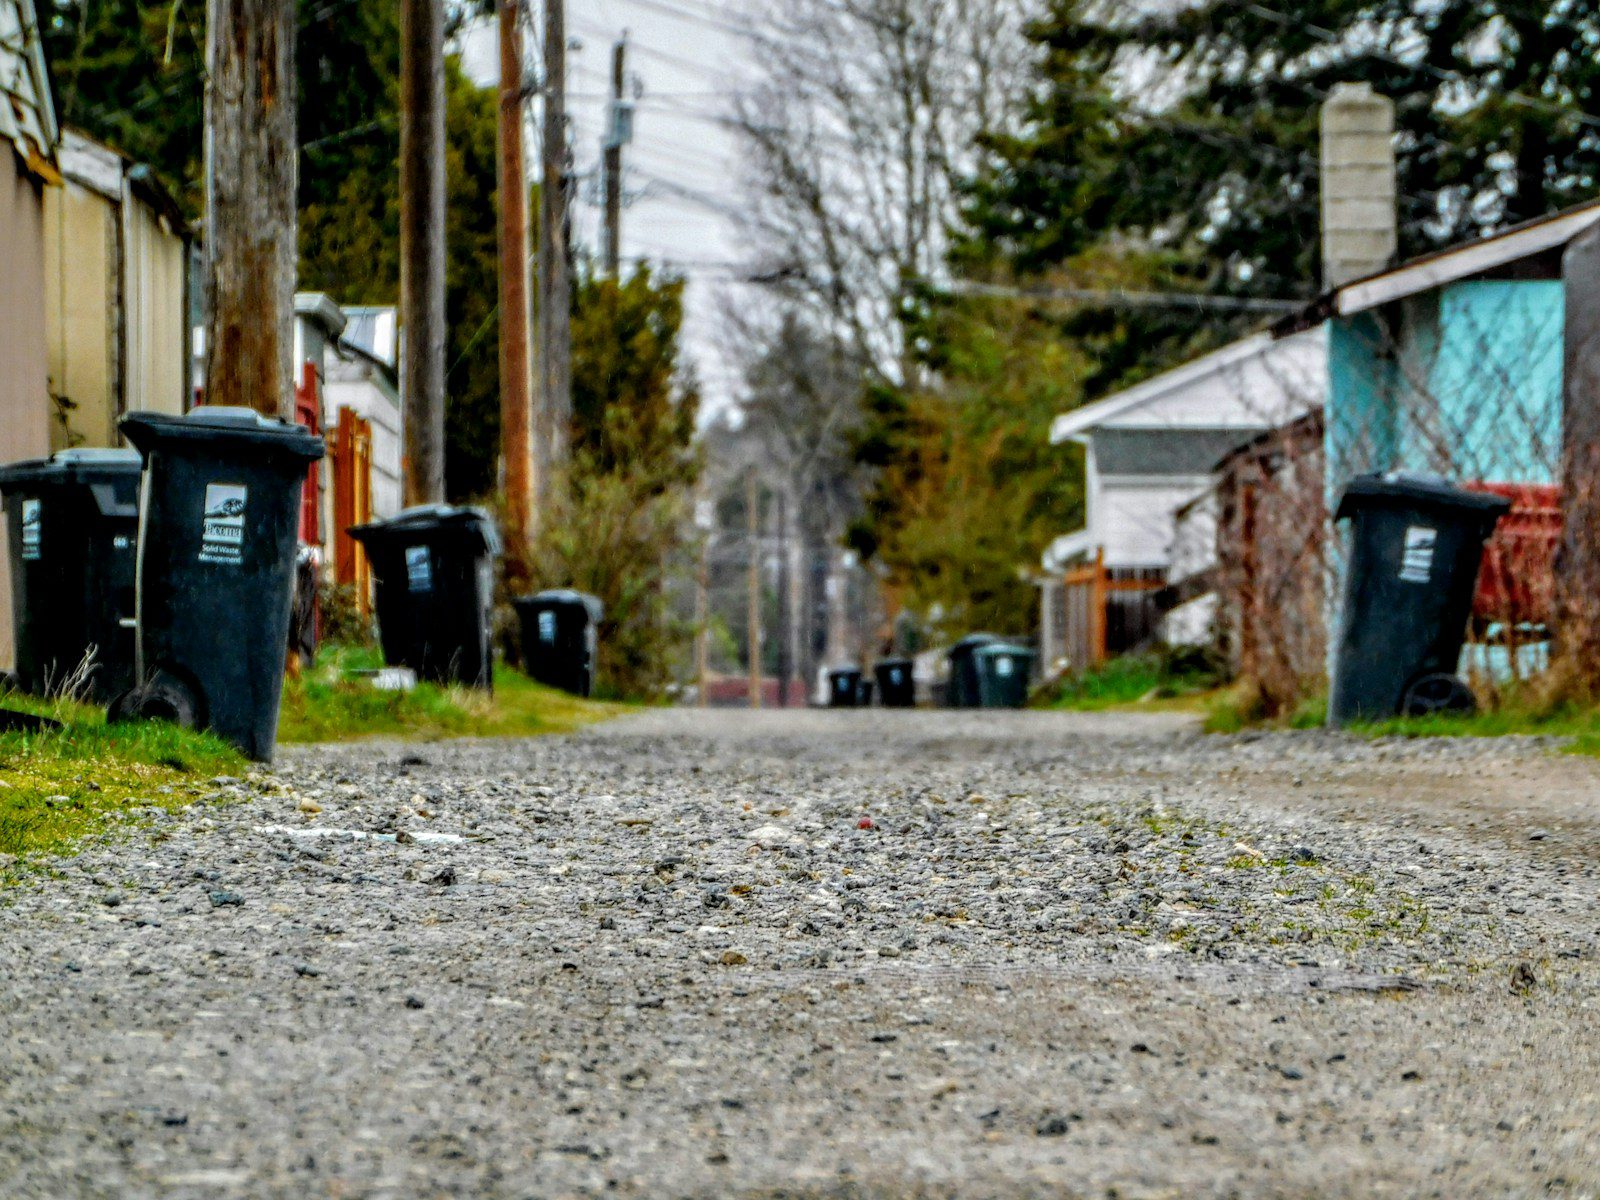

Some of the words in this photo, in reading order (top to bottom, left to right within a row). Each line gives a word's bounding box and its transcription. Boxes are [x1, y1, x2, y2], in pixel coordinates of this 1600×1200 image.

[203, 522, 242, 537] Tacoma
[202, 544, 218, 553] Solid
[219, 545, 240, 555] Waste
[198, 553, 241, 564] Management
